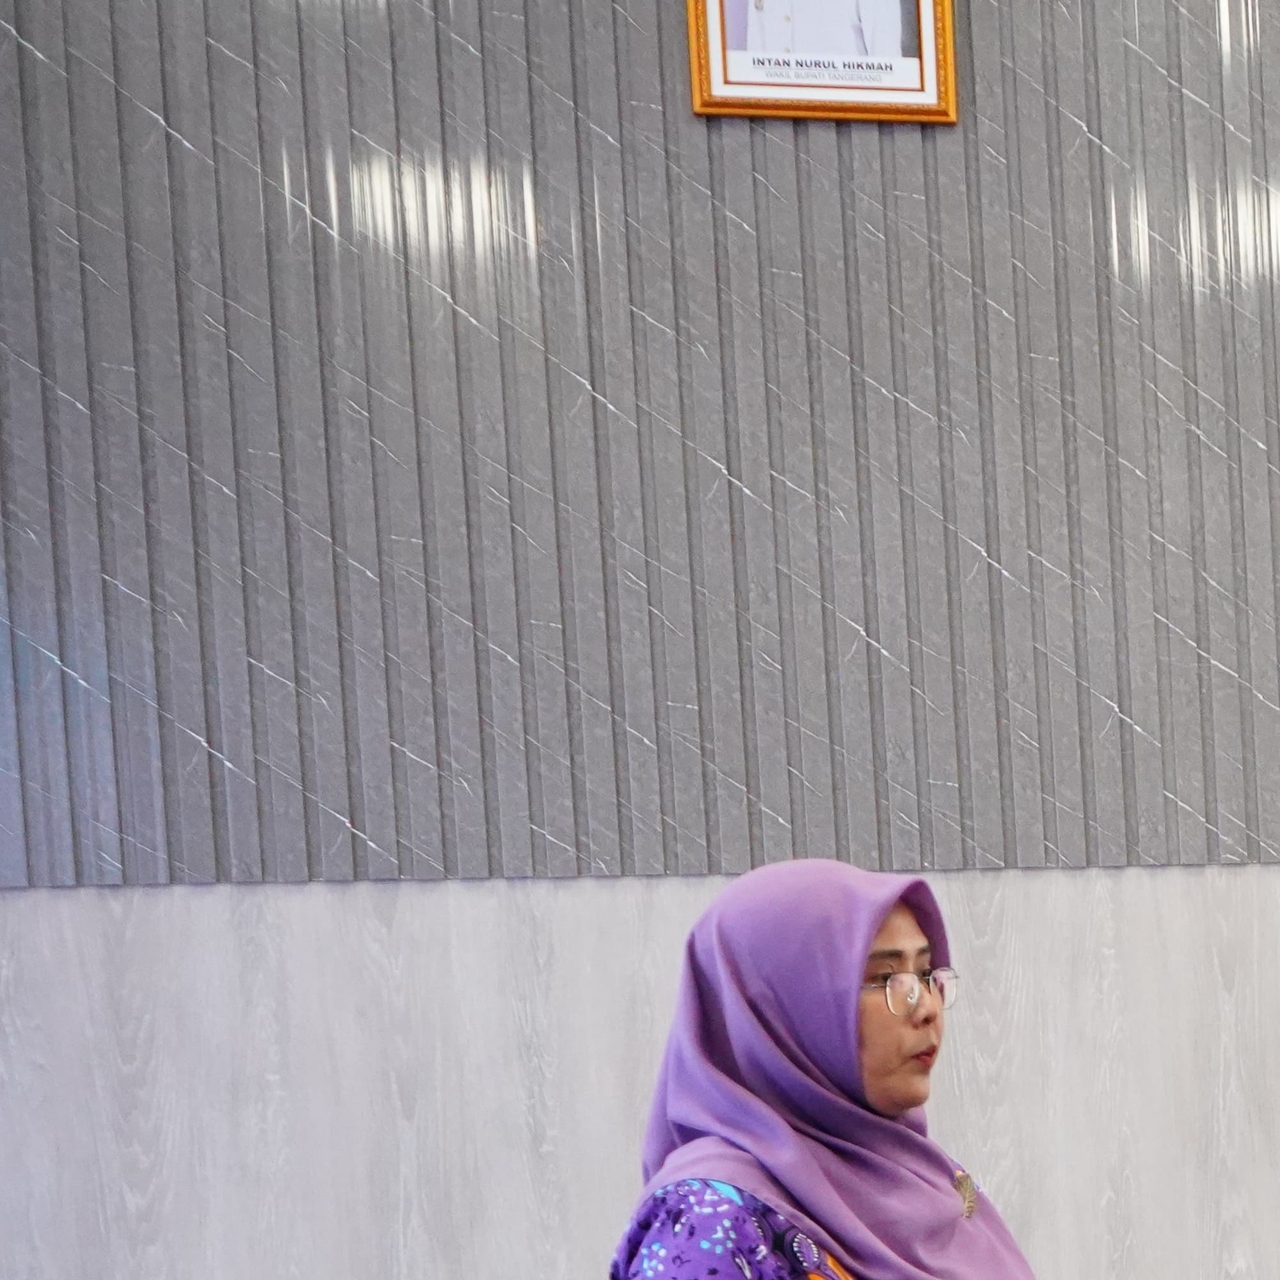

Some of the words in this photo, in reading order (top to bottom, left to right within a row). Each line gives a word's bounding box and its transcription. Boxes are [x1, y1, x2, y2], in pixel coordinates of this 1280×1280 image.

[753, 57, 791, 68] INTAN
[795, 59, 838, 70] NURUL
[842, 61, 893, 72] HIKMAH
[765, 70, 792, 79] WAKIL
[794, 71, 826, 80] BUPATI
[828, 73, 882, 83] TANGERANG
